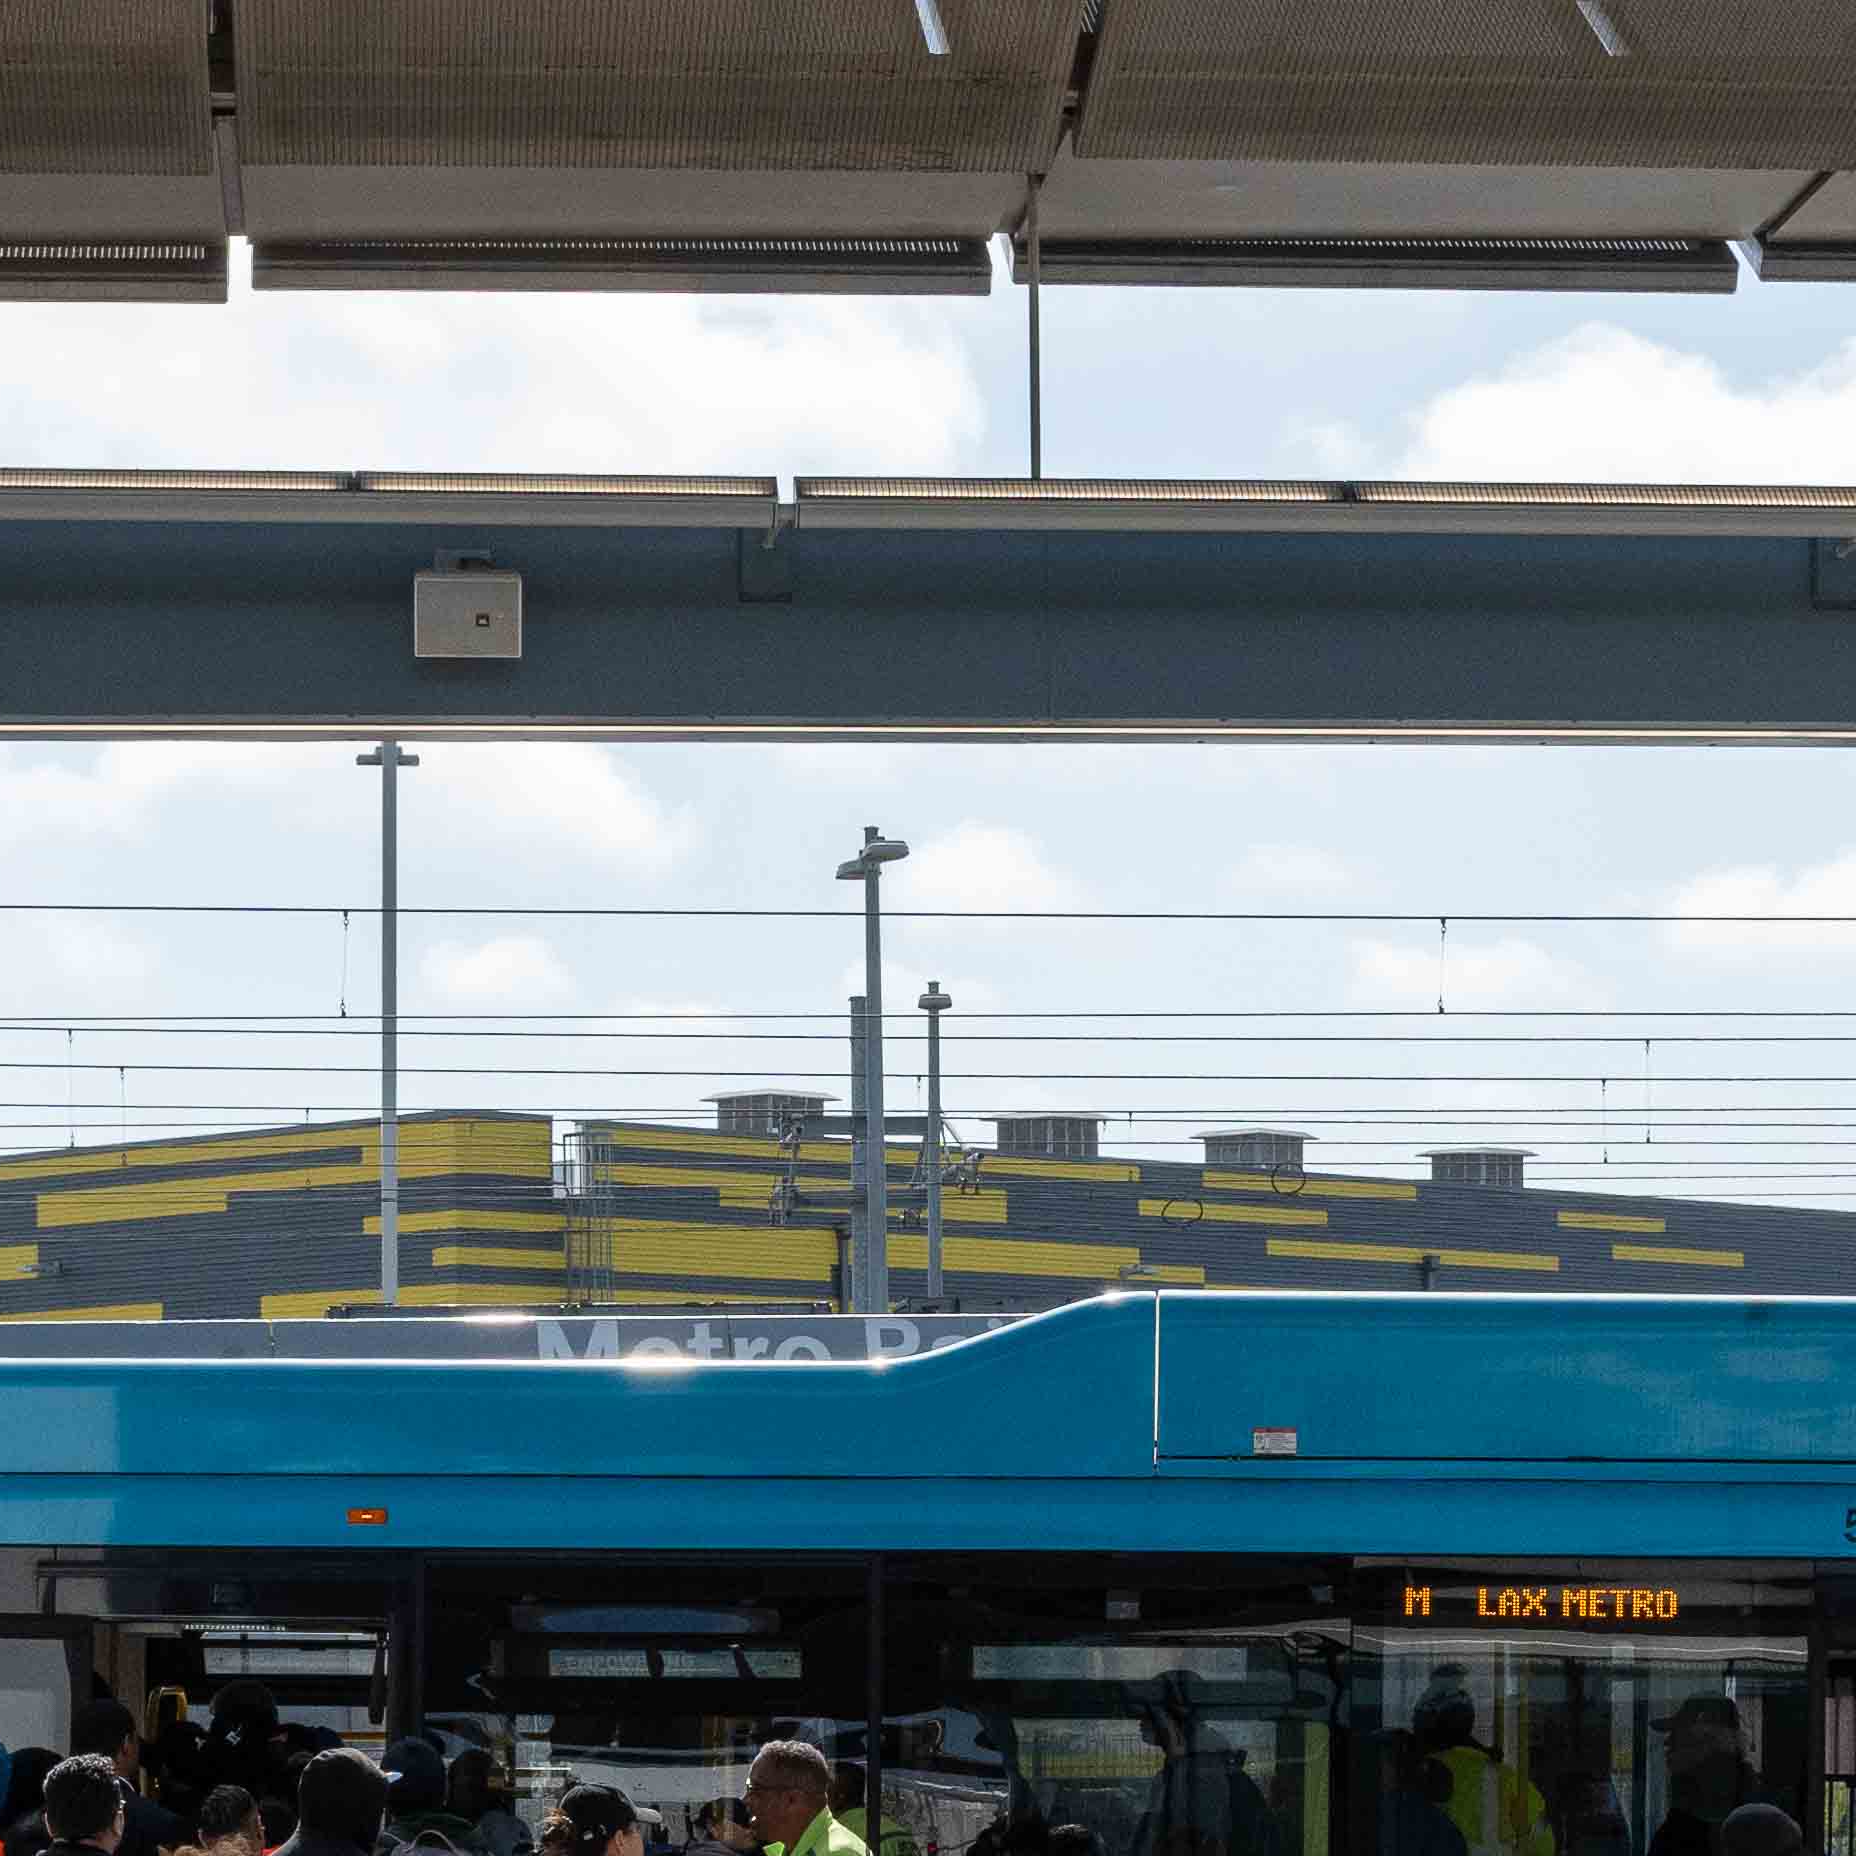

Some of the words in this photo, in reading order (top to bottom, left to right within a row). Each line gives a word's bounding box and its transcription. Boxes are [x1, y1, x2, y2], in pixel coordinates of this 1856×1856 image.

[1405, 1587, 1430, 1616] M
[1478, 1587, 1547, 1616] LAX
[1562, 1588, 1678, 1618] METRO
